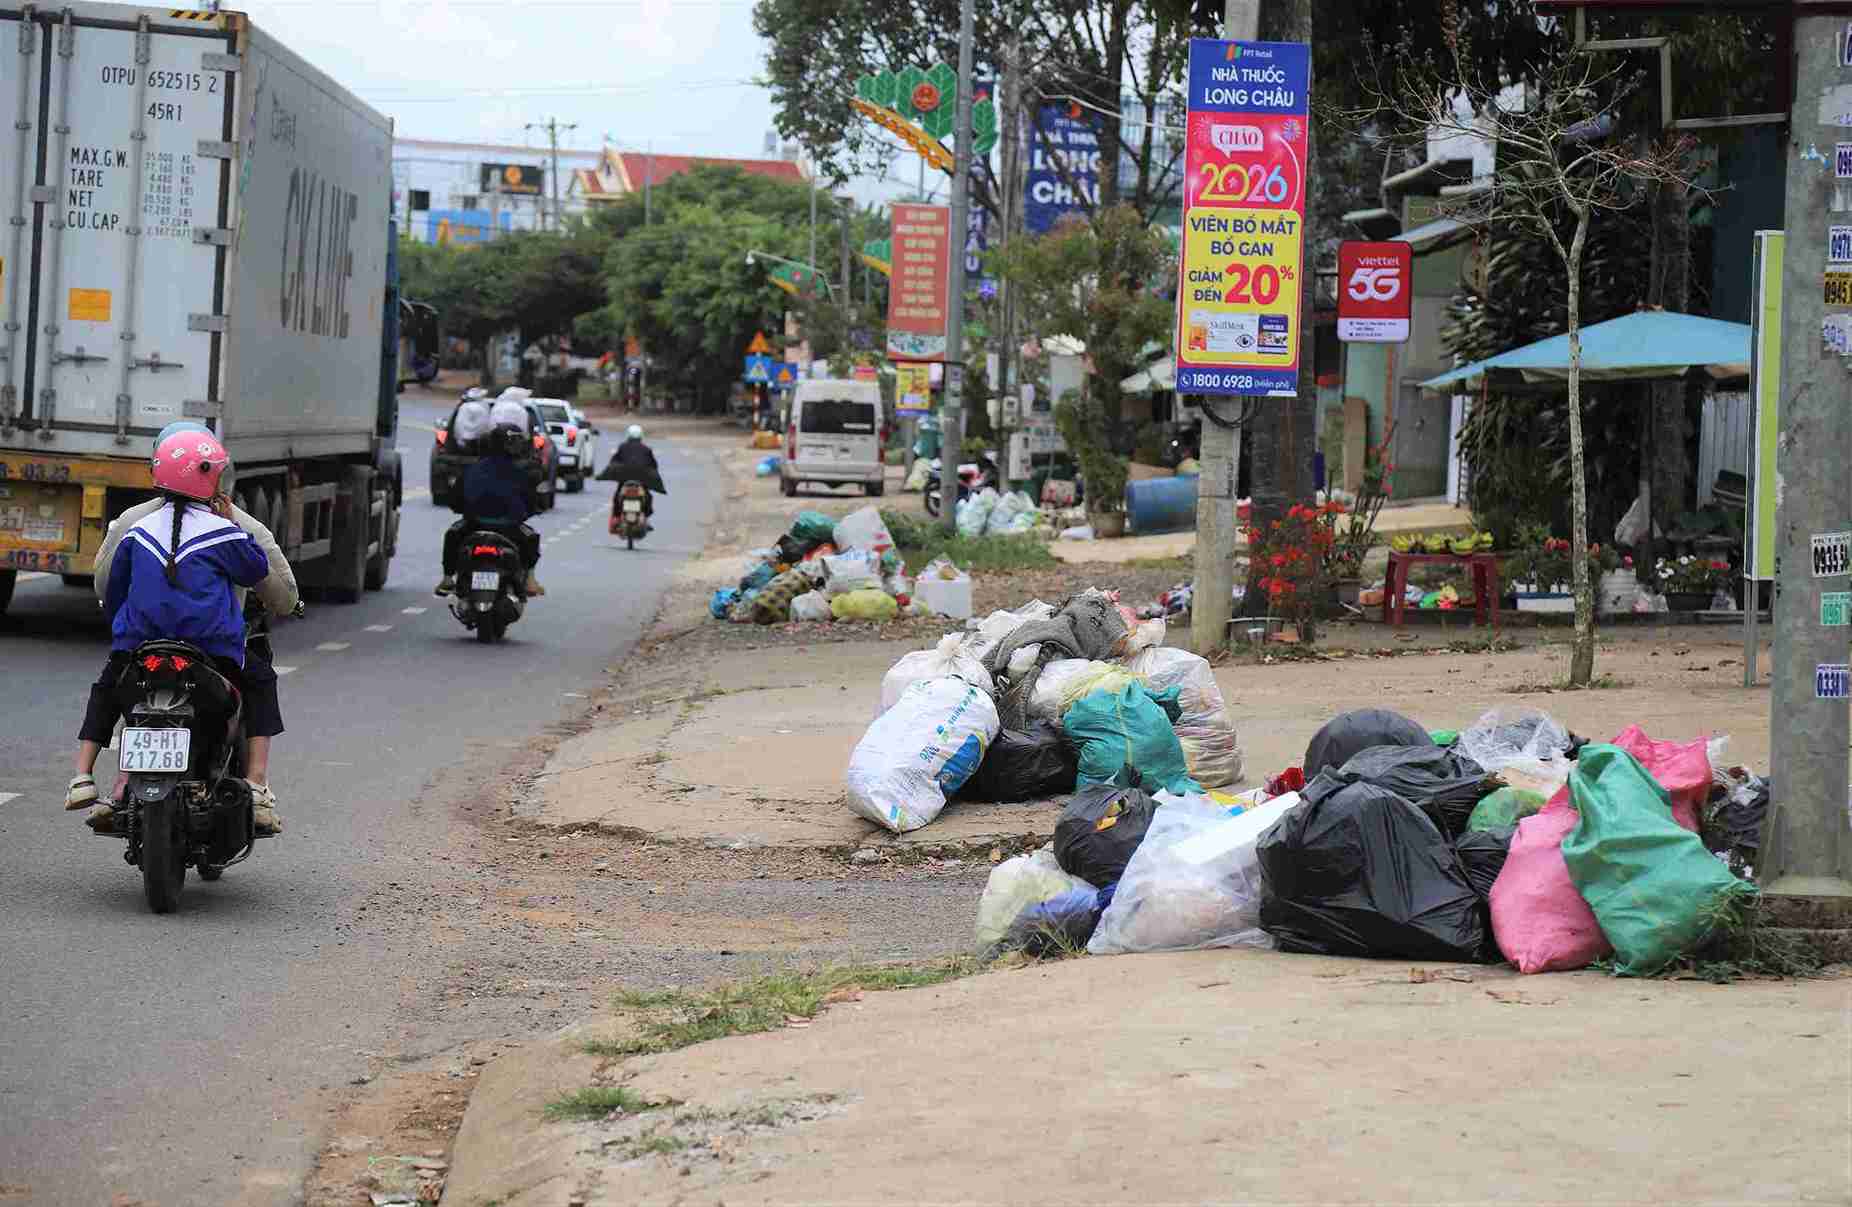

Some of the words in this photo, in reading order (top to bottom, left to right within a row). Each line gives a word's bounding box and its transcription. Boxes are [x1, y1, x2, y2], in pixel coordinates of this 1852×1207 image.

[102, 66, 136, 86] OTPU
[148, 71, 200, 91] 652515
[208, 76, 217, 93] 2
[1212, 65, 1239, 82] NHÀ
[1241, 65, 1285, 83] THUỐC
[1205, 87, 1248, 105] LONG
[1251, 87, 1294, 107] CHÂU
[147, 101, 182, 121] 45R1
[71, 147, 128, 168] MAX.G.W.
[71, 168, 104, 188] TARE
[1199, 162, 1288, 203] 2026
[68, 190, 95, 208] NET
[1190, 214, 1229, 233] VIÊN
[1261, 213, 1296, 235] MẮT
[1239, 241, 1273, 257] GAN
[1359, 256, 1399, 267] viettel
[1188, 267, 1223, 283] GIẢM
[1224, 262, 1294, 305] 20%
[1193, 285, 1222, 302] ĐẾN
[1348, 268, 1400, 302] 5G
[1193, 374, 1221, 388] 1800
[1223, 375, 1253, 389] 6928
[133, 732, 178, 750] 49-H1
[126, 751, 184, 769] 217.68
